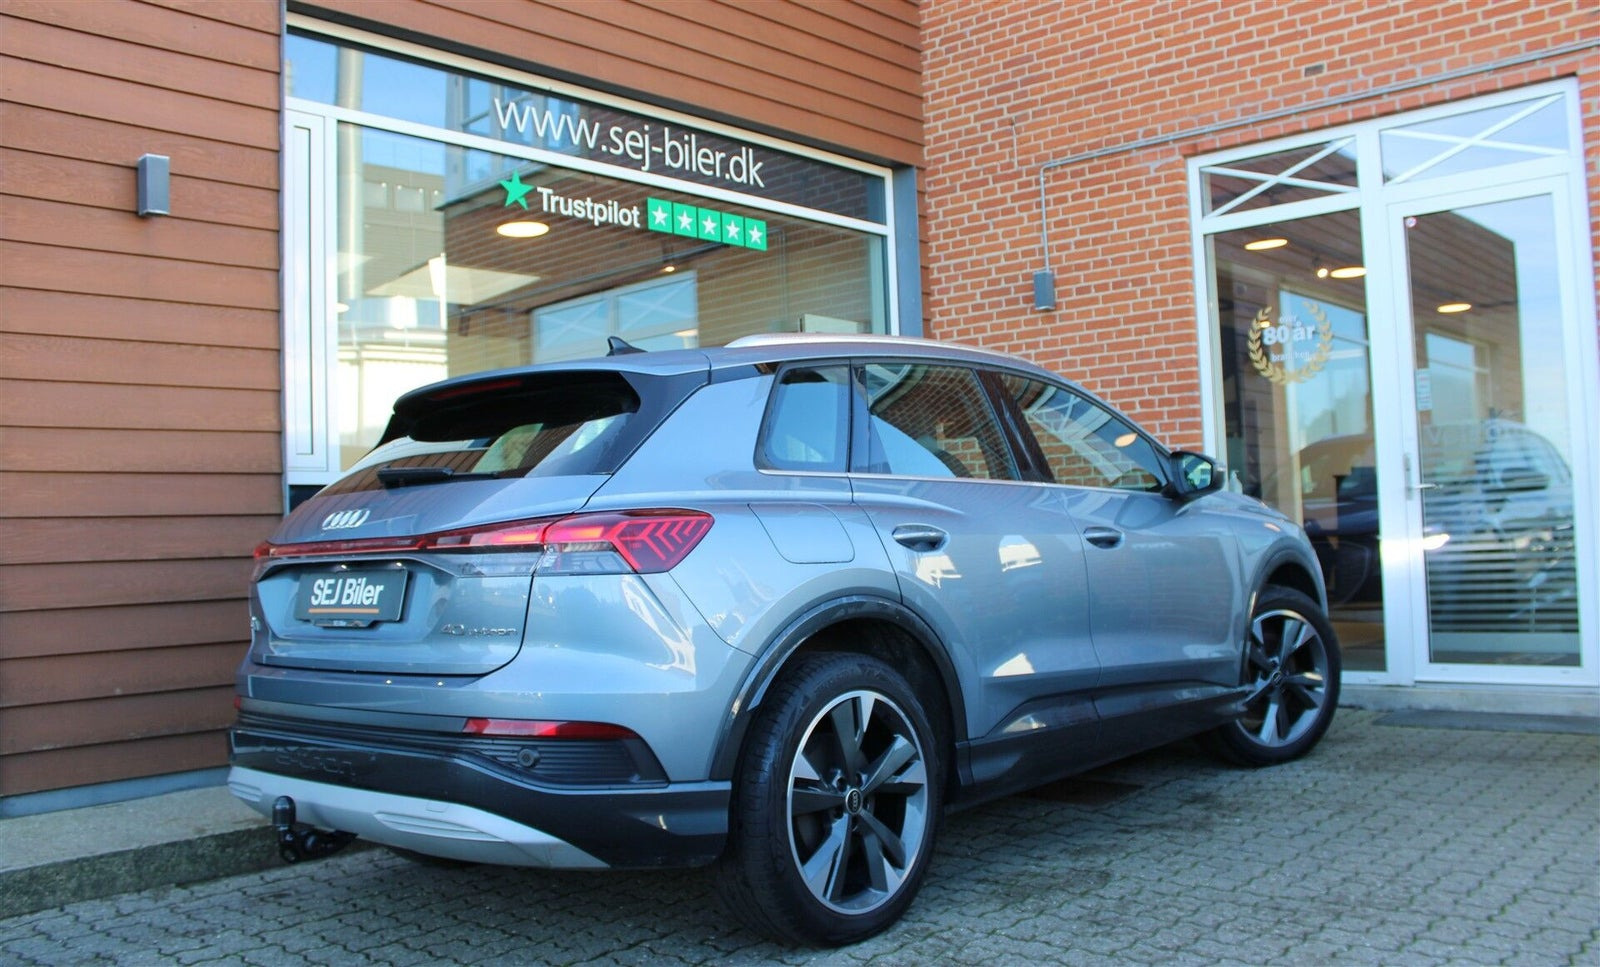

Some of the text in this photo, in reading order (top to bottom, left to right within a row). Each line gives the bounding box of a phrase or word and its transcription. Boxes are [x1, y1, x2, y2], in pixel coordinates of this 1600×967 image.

[494, 98, 766, 188] www.sej-biler.dk
[536, 186, 641, 228] Trustpilot
[1262, 320, 1316, 345] 80 år
[310, 576, 384, 607] SEJ Biler
[441, 623, 465, 636] 40
